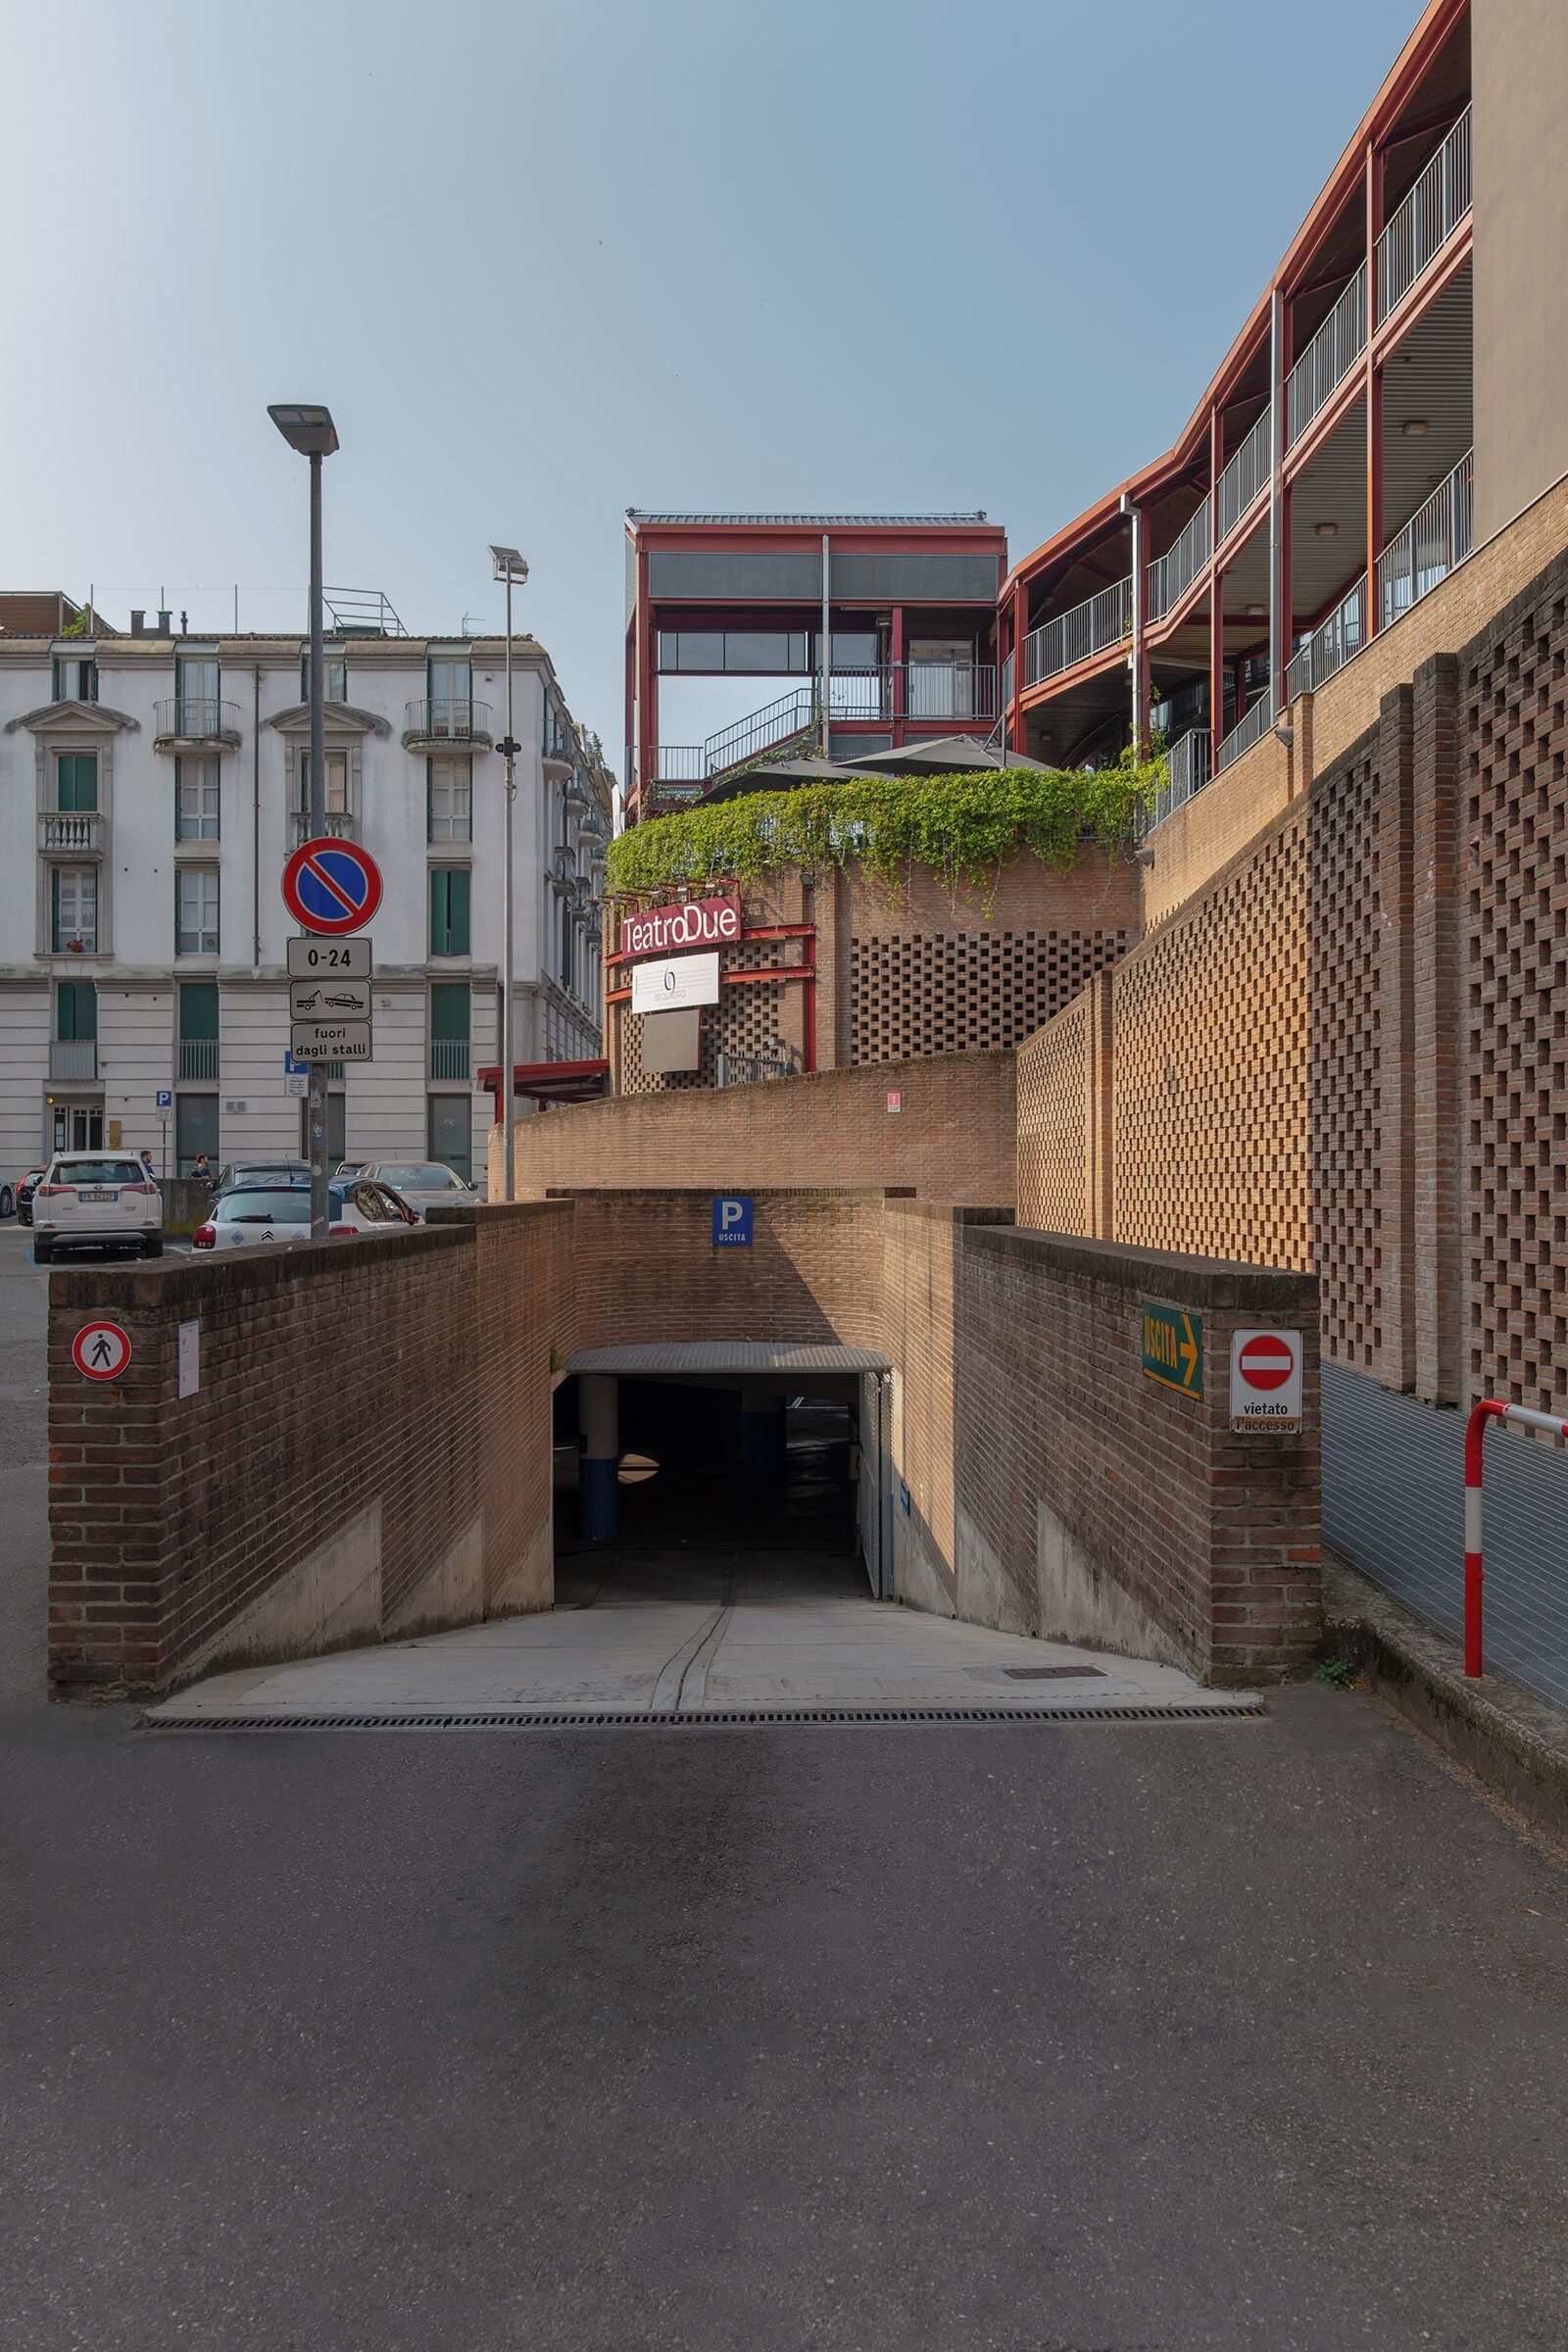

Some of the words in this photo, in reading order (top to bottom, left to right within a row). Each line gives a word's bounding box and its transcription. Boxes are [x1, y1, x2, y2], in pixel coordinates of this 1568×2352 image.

[624, 905, 737, 953] TeatroDue
[308, 949, 352, 967] 0-24
[315, 1028, 346, 1039] fuori
[296, 1044, 327, 1057] dagli
[332, 1044, 366, 1055] stalli
[159, 1092, 170, 1105] P
[721, 1200, 744, 1230] P
[718, 1233, 746, 1242] USCITA
[1144, 1316, 1178, 1369] USCITA
[1244, 1401, 1288, 1415] vietato
[1236, 1416, 1295, 1432] l'accesso
